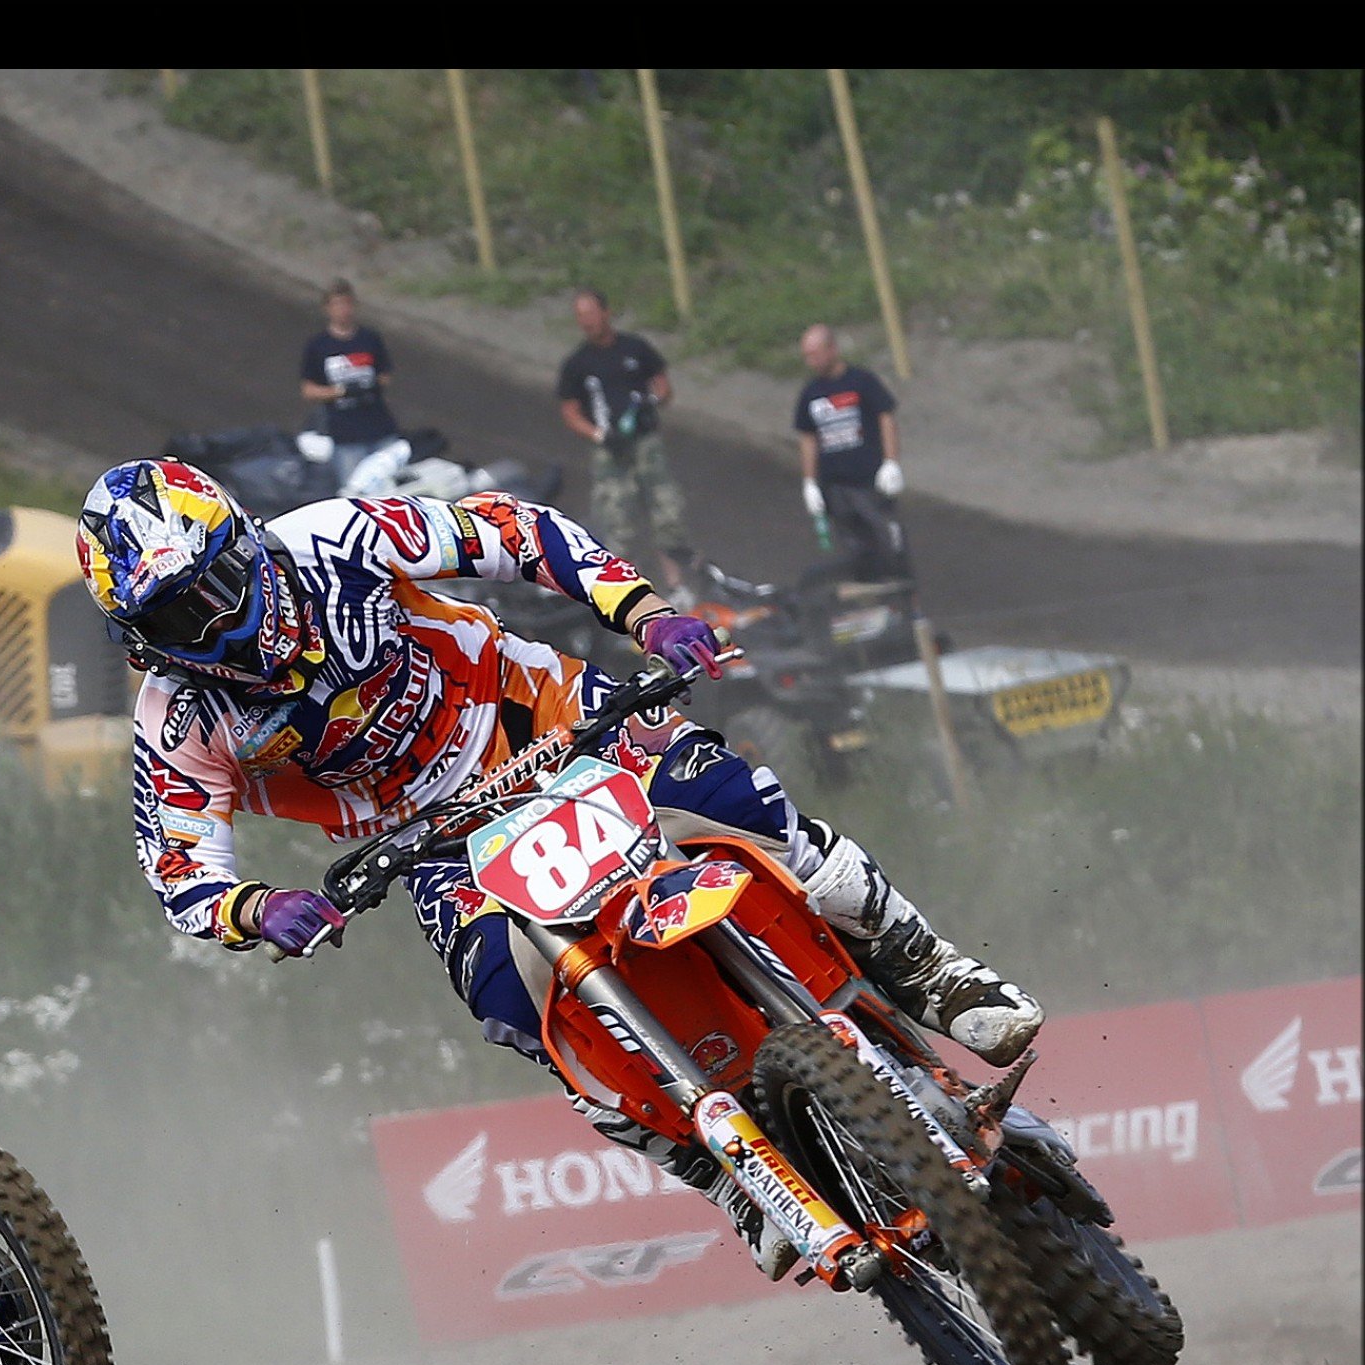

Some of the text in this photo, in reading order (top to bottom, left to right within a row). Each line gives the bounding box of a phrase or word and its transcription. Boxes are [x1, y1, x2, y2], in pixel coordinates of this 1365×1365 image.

[316, 646, 432, 787] Red Bull
[505, 764, 613, 838] MOOREX
[509, 784, 642, 913] 84
[494, 1146, 703, 1217] HON
[749, 1136, 819, 1206] PIRELLI
[755, 1171, 815, 1240] ATHENA
